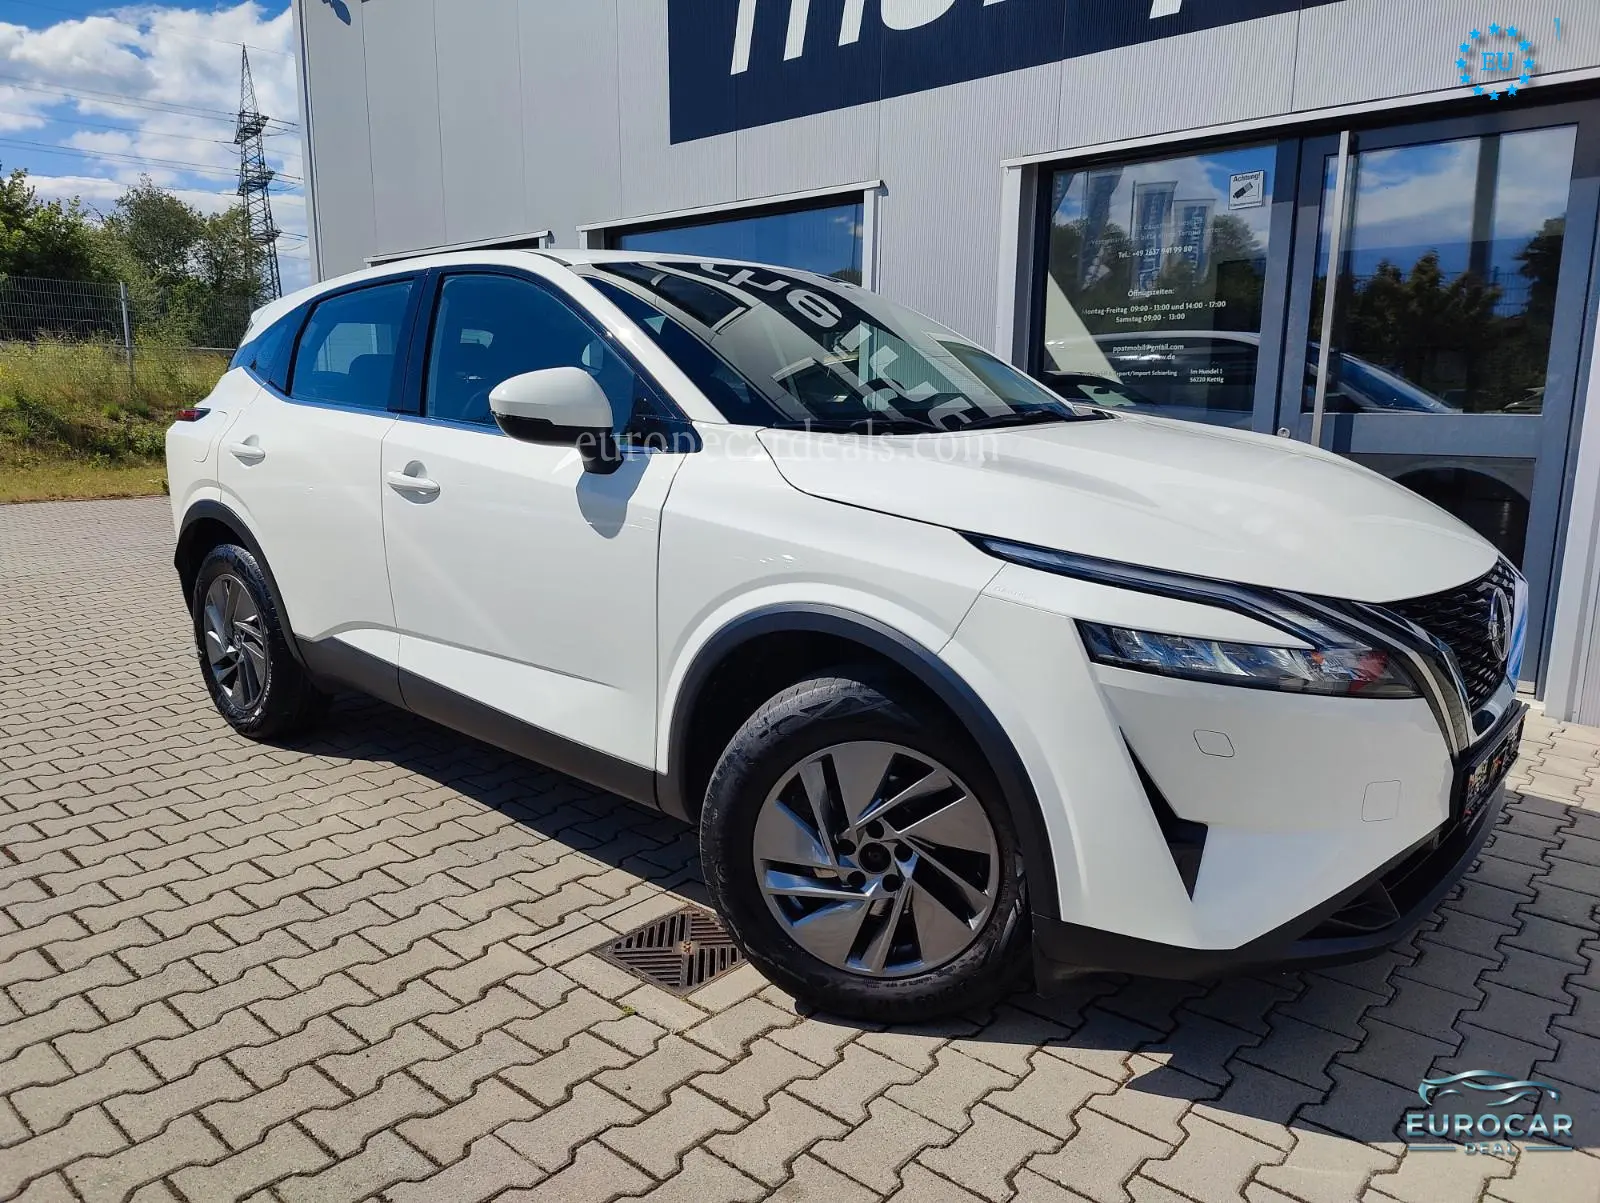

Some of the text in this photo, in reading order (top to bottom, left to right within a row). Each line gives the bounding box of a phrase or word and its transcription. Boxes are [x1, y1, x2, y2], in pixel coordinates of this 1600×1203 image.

[1233, 172, 1260, 182] Achtung!
[1130, 305, 1149, 313] 09:00
[1171, 302, 1185, 310] und
[1185, 302, 1203, 310] 14:00
[1208, 300, 1227, 308] 17:00
[1115, 316, 1142, 324] Samstag
[1143, 313, 1162, 322] 09:00
[1168, 313, 1186, 321] 13:00
[1206, 376, 1225, 384] Kettig
